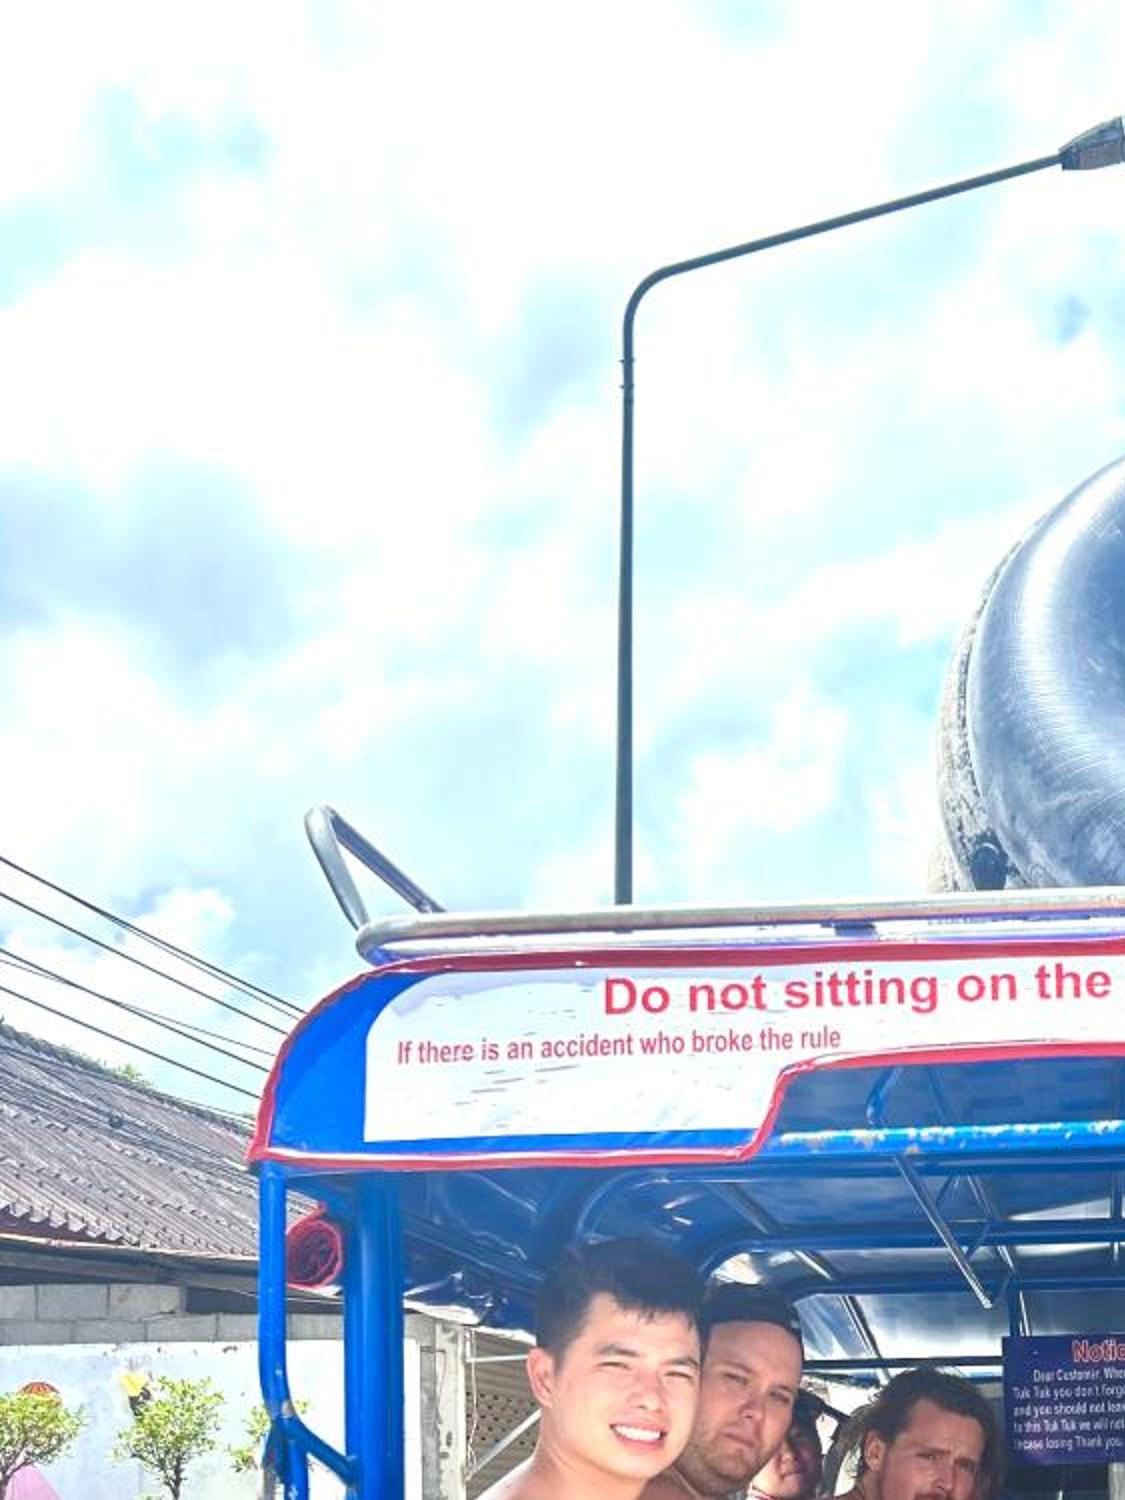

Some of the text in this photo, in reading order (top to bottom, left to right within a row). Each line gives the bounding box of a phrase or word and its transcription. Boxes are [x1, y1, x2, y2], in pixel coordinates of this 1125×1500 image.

[605, 978, 670, 1015] Do
[689, 975, 767, 1012] not
[781, 964, 938, 1014] sitting
[957, 974, 1017, 1002] on
[1035, 963, 1111, 1000] the
[398, 1026, 840, 1063] If there is an accident who broke the rule
[1053, 1386, 1072, 1400] you
[1013, 1404, 1032, 1417] and
[1033, 1406, 1052, 1418] you
[1054, 1402, 1086, 1416] should
[1089, 1402, 1105, 1414] not
[1060, 1419, 1076, 1432] Tuk
[1074, 1434, 1104, 1448] Thank
